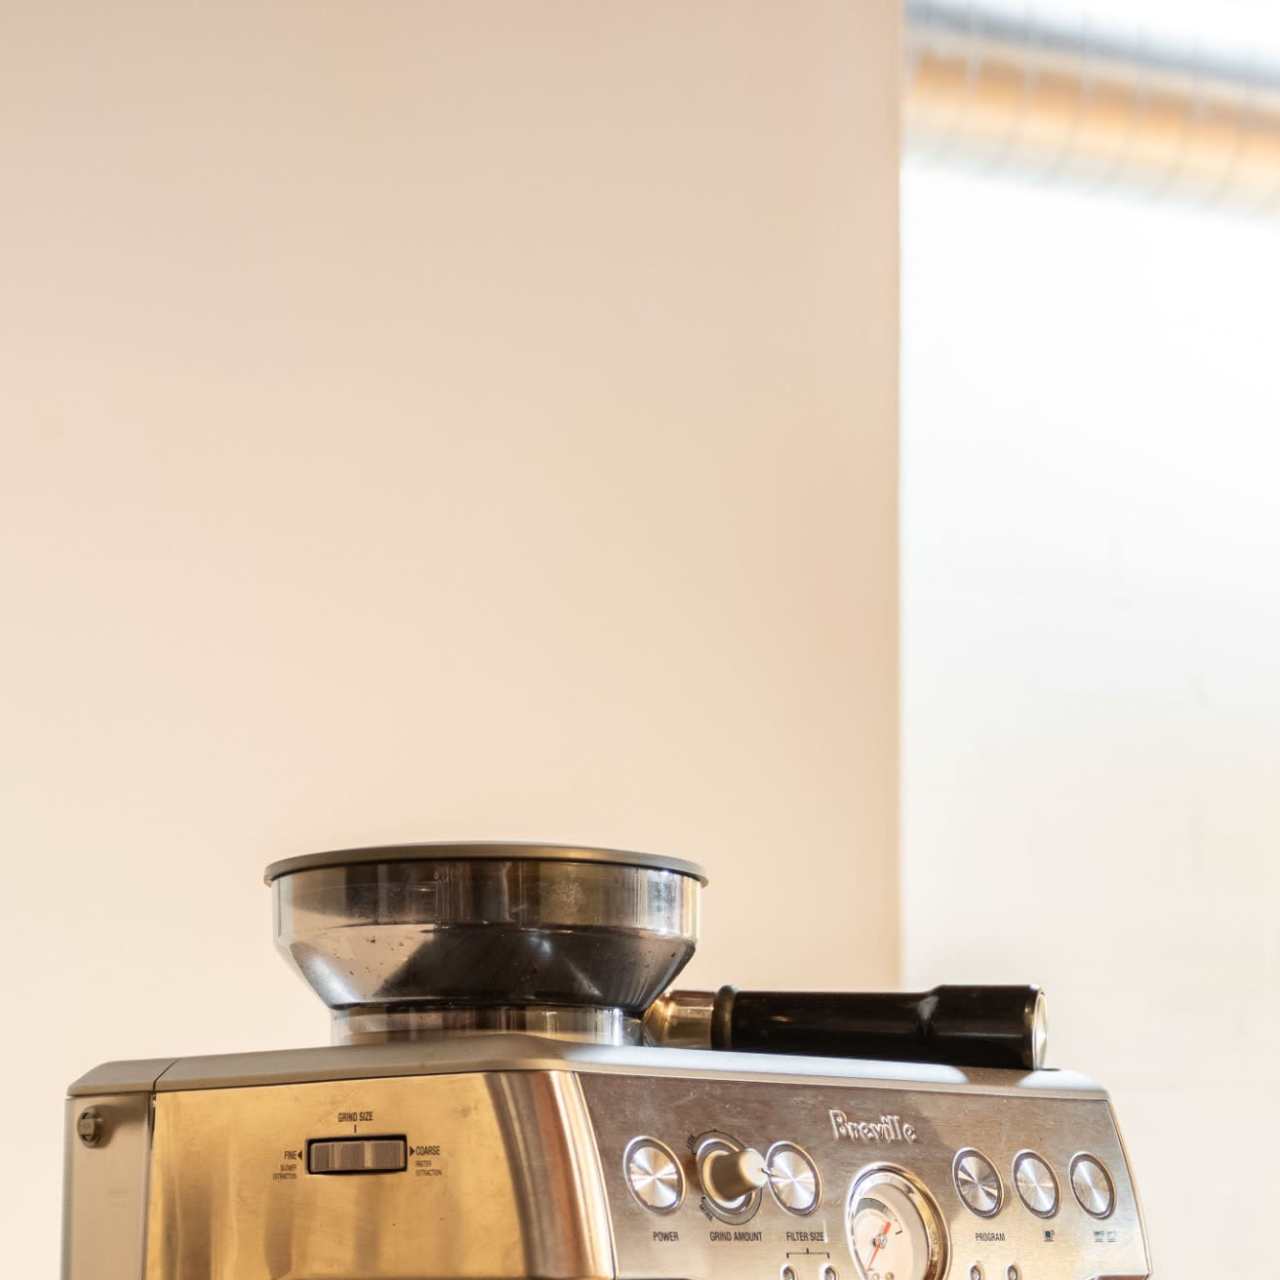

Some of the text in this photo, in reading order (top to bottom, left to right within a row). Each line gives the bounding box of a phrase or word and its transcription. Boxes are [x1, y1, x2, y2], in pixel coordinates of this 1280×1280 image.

[337, 1111, 374, 1122] GRIND SIZE
[828, 1109, 917, 1143] Breville
[416, 1145, 440, 1155] COARSE
[652, 1231, 679, 1242] POWER
[709, 1231, 762, 1242] GRIND AMOUNT
[785, 1231, 825, 1242] FILTER SIZE
[975, 1232, 1007, 1242] PROGRAM
